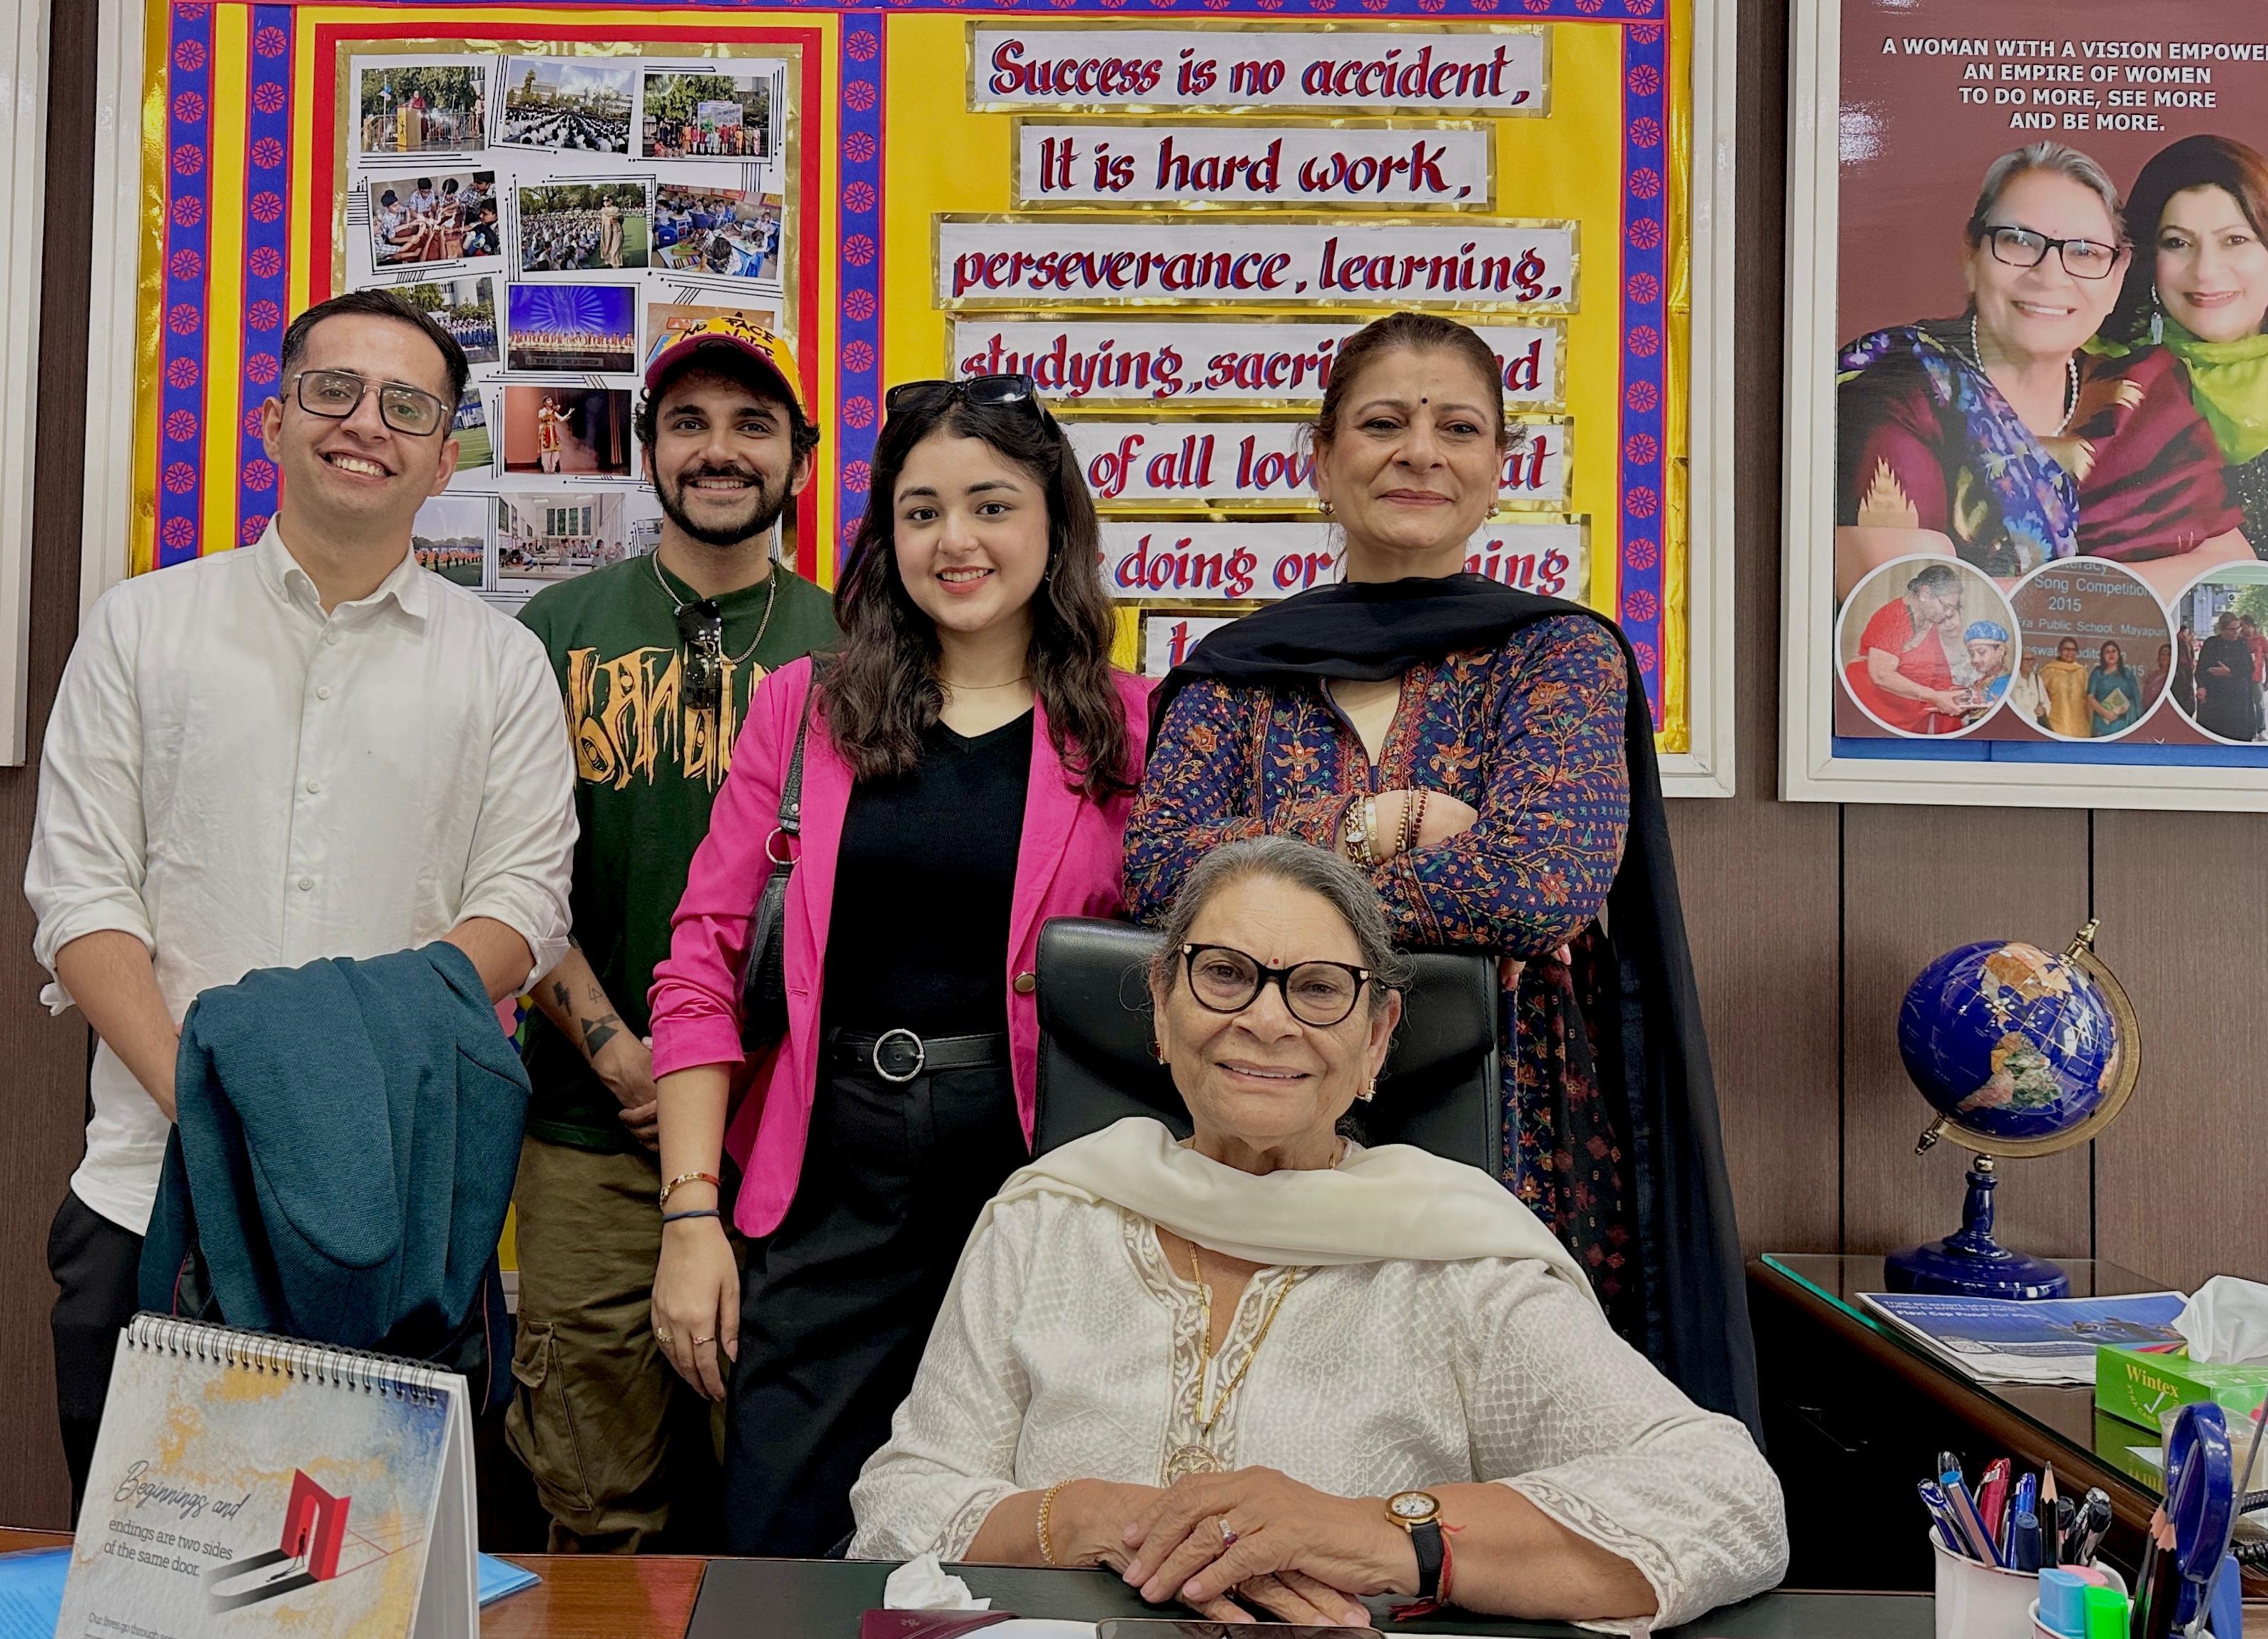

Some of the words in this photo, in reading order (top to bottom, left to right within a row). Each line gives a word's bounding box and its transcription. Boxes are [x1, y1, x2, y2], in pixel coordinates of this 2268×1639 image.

[1882, 38, 1897, 55] A
[1903, 39, 1989, 56] WOMAN
[1995, 40, 2055, 58] WITH
[2061, 41, 2076, 58] A
[2081, 41, 2162, 59] VISION
[2169, 43, 2268, 61] EMPOWE
[990, 39, 1161, 96] Success
[1178, 49, 1216, 96] is
[1230, 57, 1285, 95] no
[1301, 44, 1530, 106] accident,
[1964, 64, 1994, 81] AN
[2000, 64, 2085, 83] EMPIRE
[2090, 66, 2118, 82] OF
[2124, 66, 2211, 84] WOMEN
[1959, 87, 1988, 104] TO
[1995, 88, 2026, 105] DO
[2033, 89, 2101, 109] MORE,
[2108, 91, 2147, 107] SEE
[2154, 91, 2217, 108] MORE
[2010, 113, 2055, 131] AND
[2063, 113, 2090, 131] BE
[2096, 114, 2165, 131] MORE.
[1039, 136, 1080, 193] It
[1094, 143, 1134, 193] is
[1156, 136, 1282, 194] hard
[952, 247, 1307, 298] perseverance,
[1321, 237, 1562, 303] learning,
[1088, 434, 1144, 499] of
[1146, 435, 1215, 489] all
[1236, 435, 1319, 491] lov
[1115, 534, 1257, 599] doing
[1273, 552, 1334, 589] or
[2035, 575, 2069, 594] Song
[2048, 597, 2082, 612] 2015
[2038, 618, 2072, 631] Public
[2125, 1364, 2179, 1399] Wintex
[2137, 1406, 2157, 1424] CARE
[114, 1460, 209, 1520] Beginnings
[212, 1493, 251, 1521] and
[109, 1519, 155, 1541] endings
[156, 1530, 176, 1546] are
[178, 1535, 200, 1552] two
[202, 1540, 233, 1561] sides
[104, 1540, 118, 1554] of
[118, 1541, 136, 1560] the
[138, 1549, 170, 1568] same
[171, 1556, 200, 1577] door.
